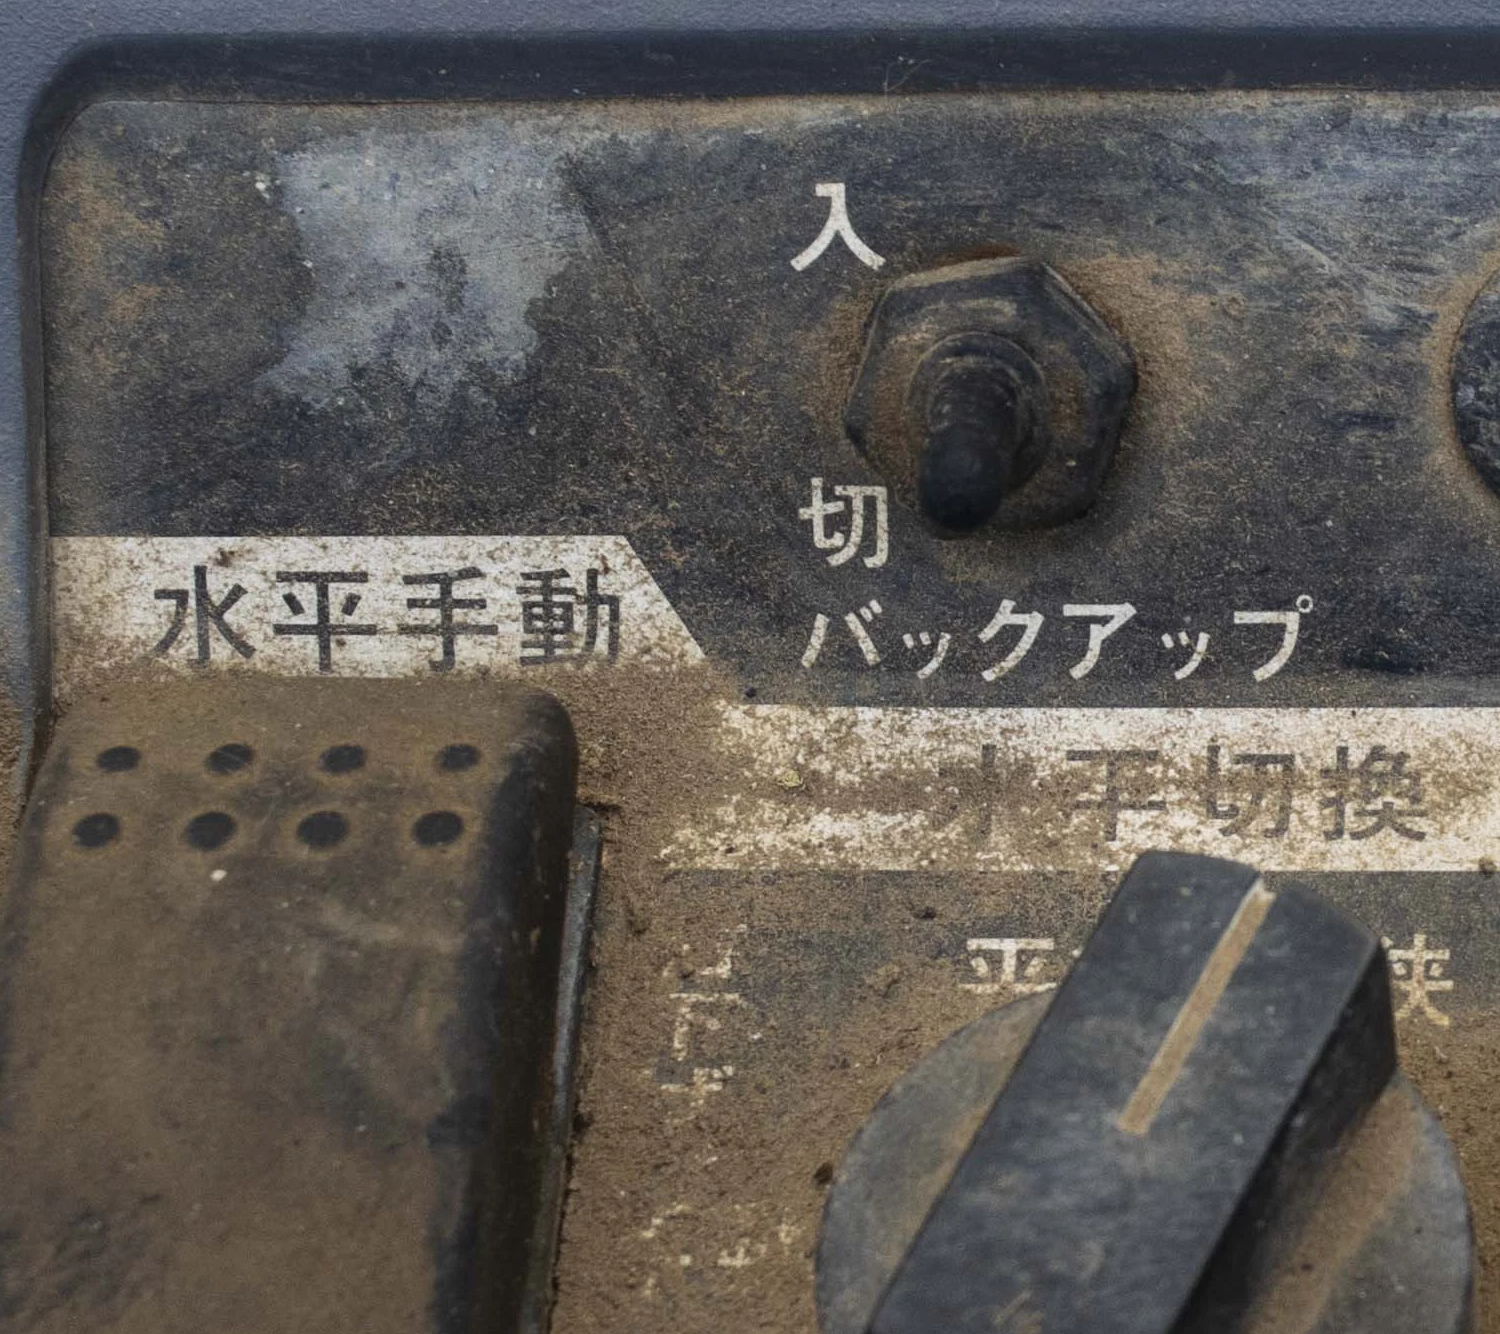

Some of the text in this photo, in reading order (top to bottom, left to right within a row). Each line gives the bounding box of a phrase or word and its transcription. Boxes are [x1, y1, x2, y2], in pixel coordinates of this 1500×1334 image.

[790, 181, 886, 272] 入
[798, 477, 889, 569] 切
[152, 565, 623, 669] 水平手動
[800, 594, 1314, 682] バックアップ
